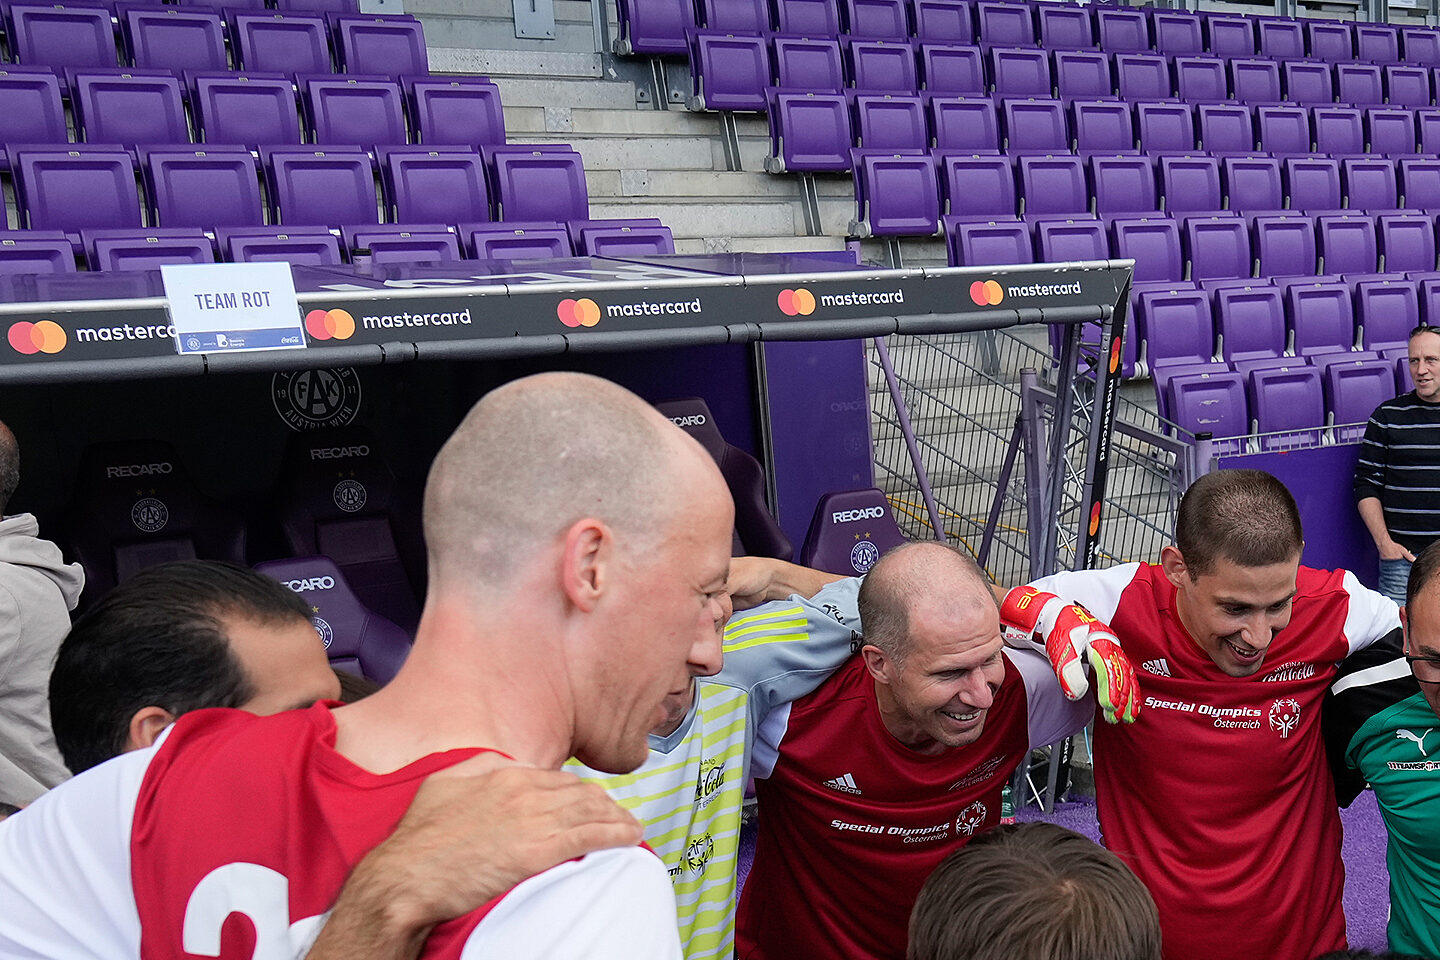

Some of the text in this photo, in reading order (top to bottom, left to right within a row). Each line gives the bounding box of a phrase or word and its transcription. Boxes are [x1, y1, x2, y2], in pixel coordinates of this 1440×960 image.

[821, 289, 904, 307] mastercard
[1008, 281, 1082, 299] mastercard
[195, 291, 272, 310] TEAM ROT
[607, 298, 702, 318] mastercard
[363, 309, 472, 330] mastercard
[1099, 379, 1115, 461] mastercard
[310, 445, 370, 460] RECARO
[106, 462, 173, 478] RECARO
[832, 506, 885, 524] RECARO
[1144, 696, 1262, 718] Special Olympics
[1213, 717, 1261, 729] Österreich
[822, 781, 863, 796] adidas
[831, 819, 951, 838] Special Olympics
[903, 832, 948, 844] Österreich
